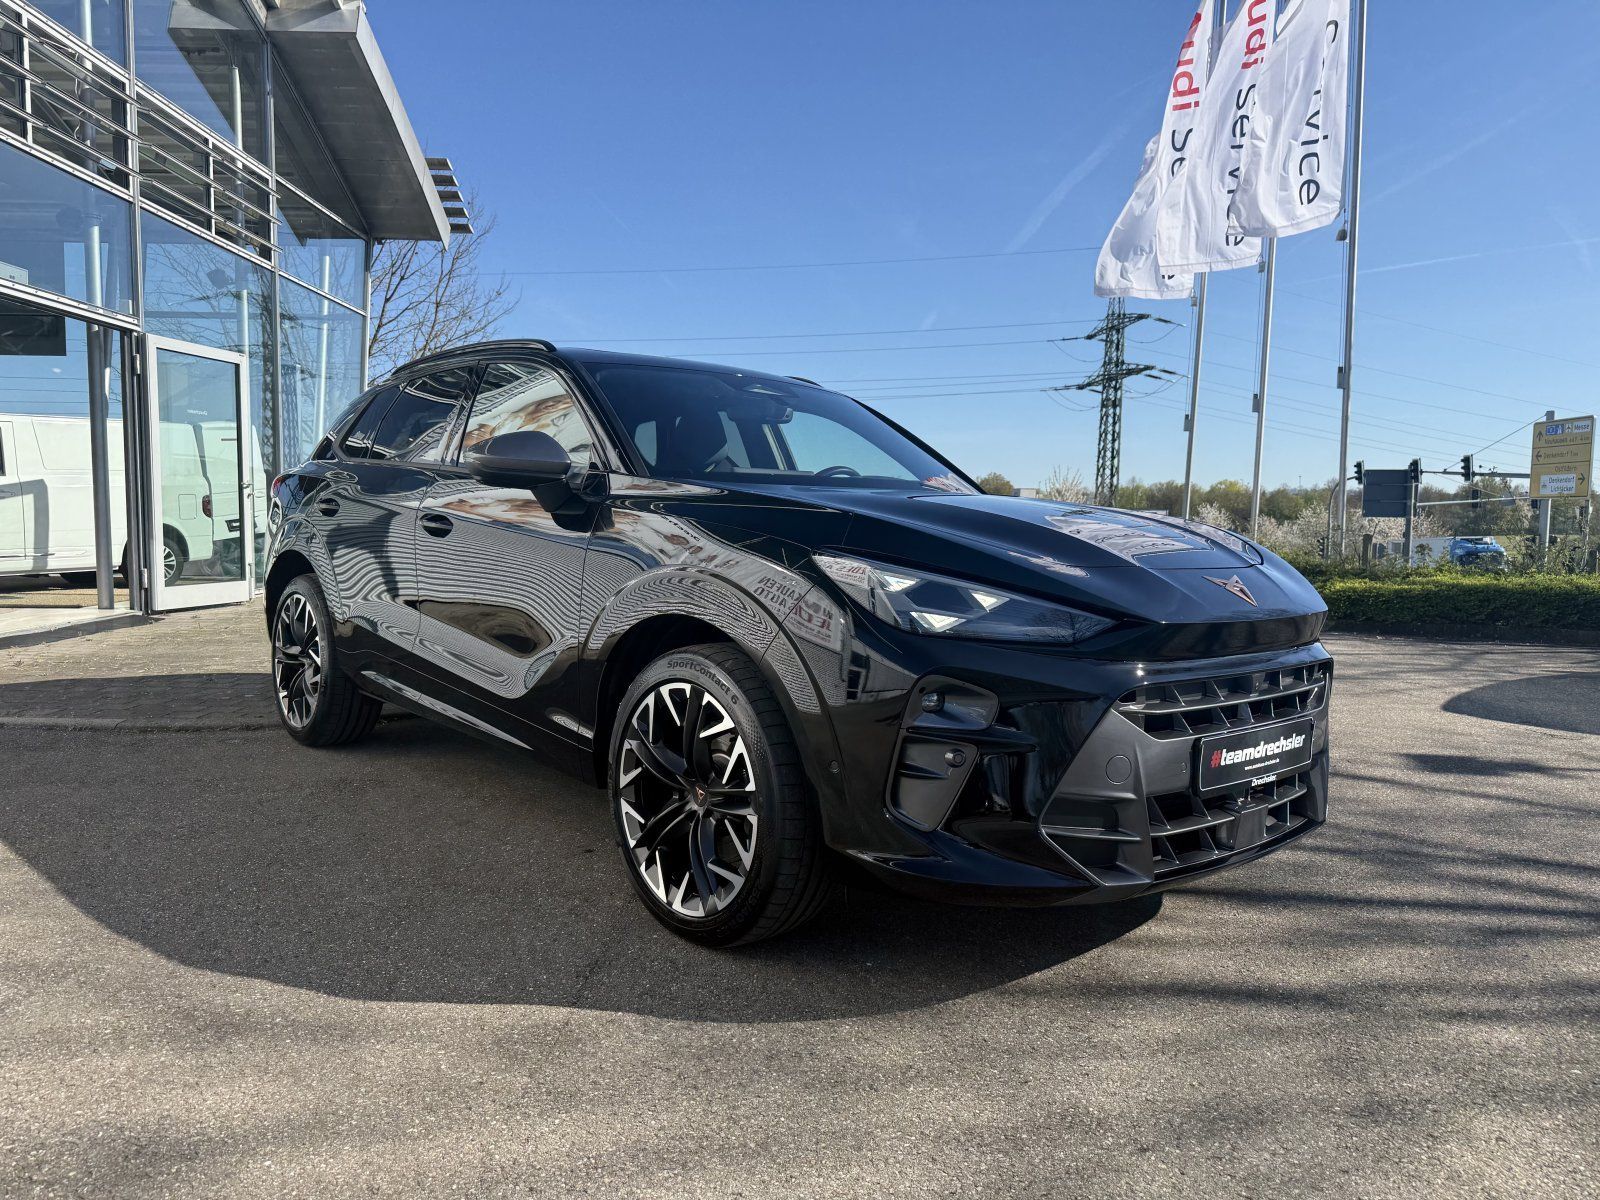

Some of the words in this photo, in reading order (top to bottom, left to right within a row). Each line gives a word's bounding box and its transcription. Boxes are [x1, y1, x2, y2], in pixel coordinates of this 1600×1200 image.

[667, 660, 731, 696] SportContact
[731, 695, 739, 705] 6
[1210, 733, 1306, 768] #teamdrechsler
